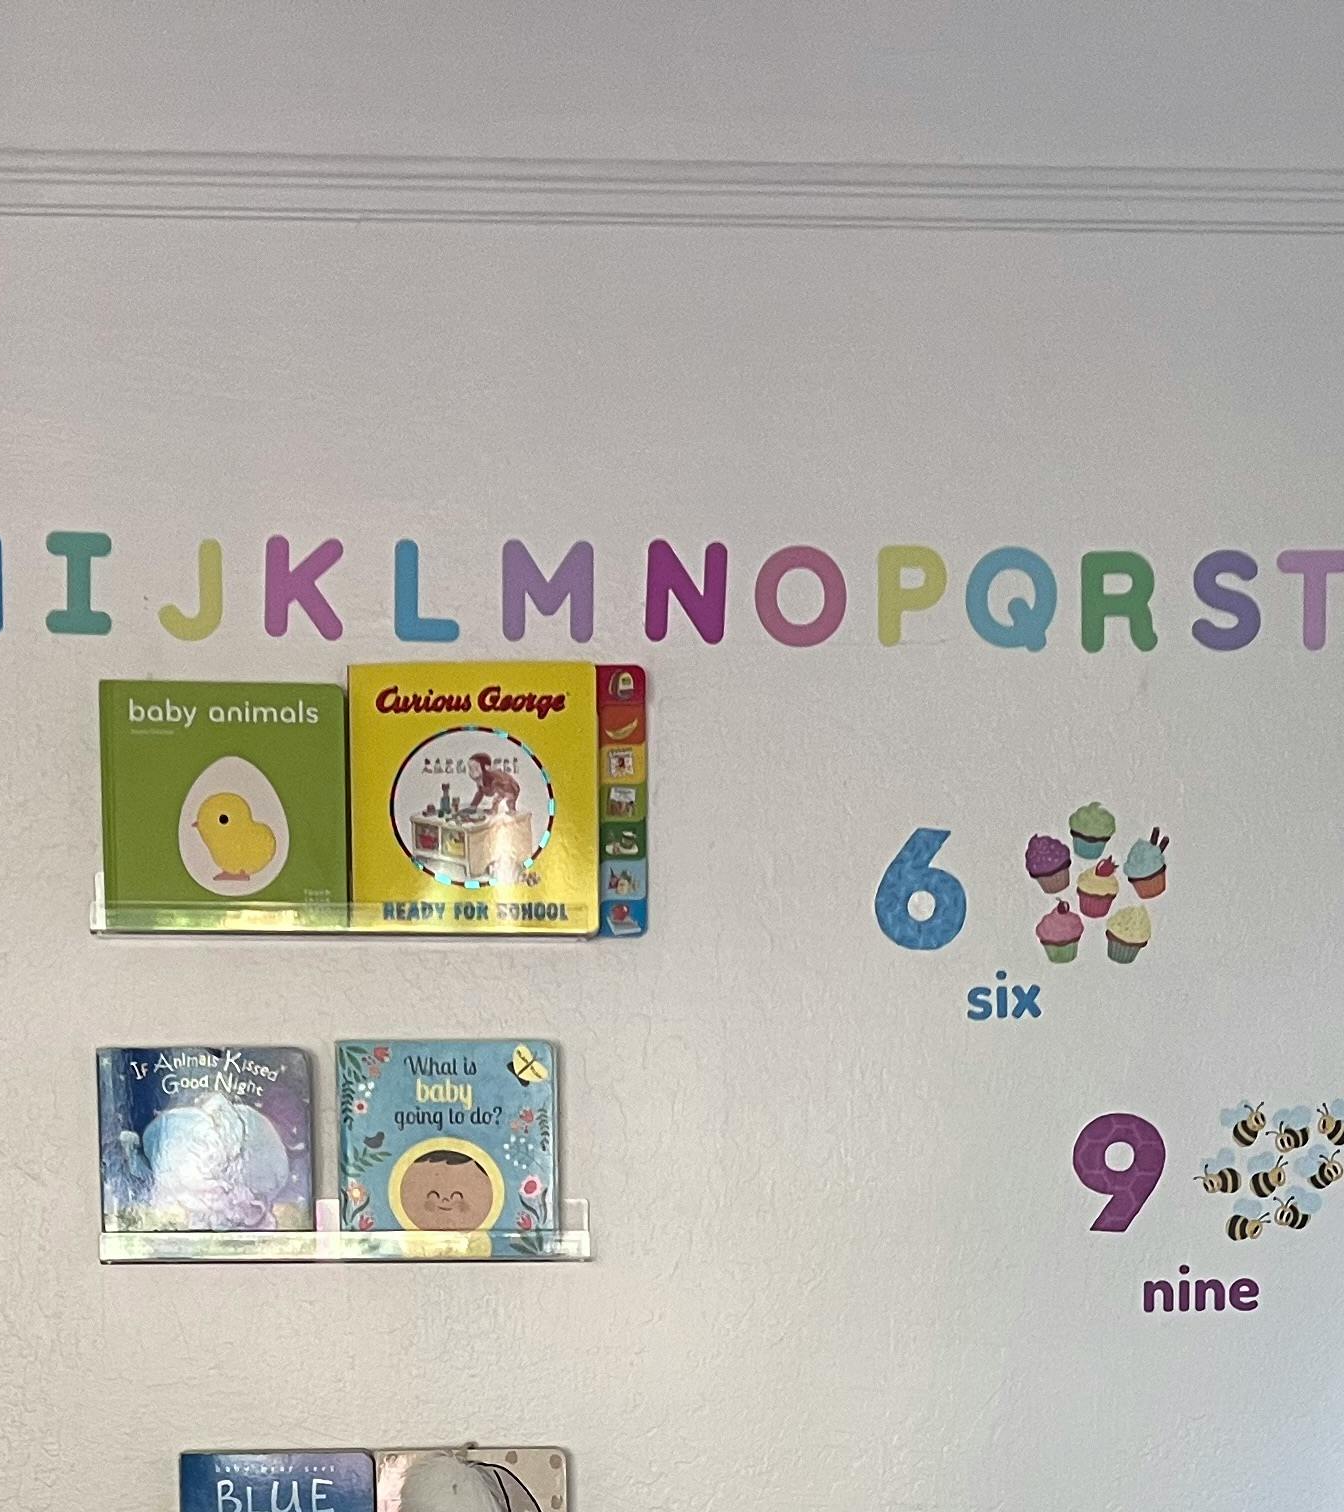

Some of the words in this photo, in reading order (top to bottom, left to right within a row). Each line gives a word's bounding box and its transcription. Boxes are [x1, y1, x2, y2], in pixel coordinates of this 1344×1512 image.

[45, 530, 112, 636] I
[158, 538, 224, 642] J
[264, 534, 344, 642] K
[394, 538, 460, 642] L
[502, 538, 595, 644] M
[644, 538, 728, 645] N
[755, 545, 847, 648] O
[877, 544, 949, 647] P
[965, 546, 1058, 652] Q
[1081, 550, 1158, 653] R
[1191, 549, 1262, 652] S
[128, 698, 197, 728] baby
[208, 700, 320, 724] animals
[374, 685, 472, 714] Curious
[476, 686, 568, 720] George
[874, 827, 967, 951] 6
[382, 901, 446, 921] READY
[454, 901, 489, 921] FOR
[496, 902, 568, 921] SCHOOL
[966, 970, 1043, 1021] six
[403, 1056, 457, 1076] What
[463, 1056, 477, 1075] is
[161, 1074, 208, 1095] Good
[416, 1078, 472, 1110] baby
[394, 1106, 443, 1131] going
[449, 1108, 464, 1125] to
[470, 1106, 502, 1125] do?
[1072, 1113, 1166, 1233] 9
[1143, 1265, 1261, 1313] nine
